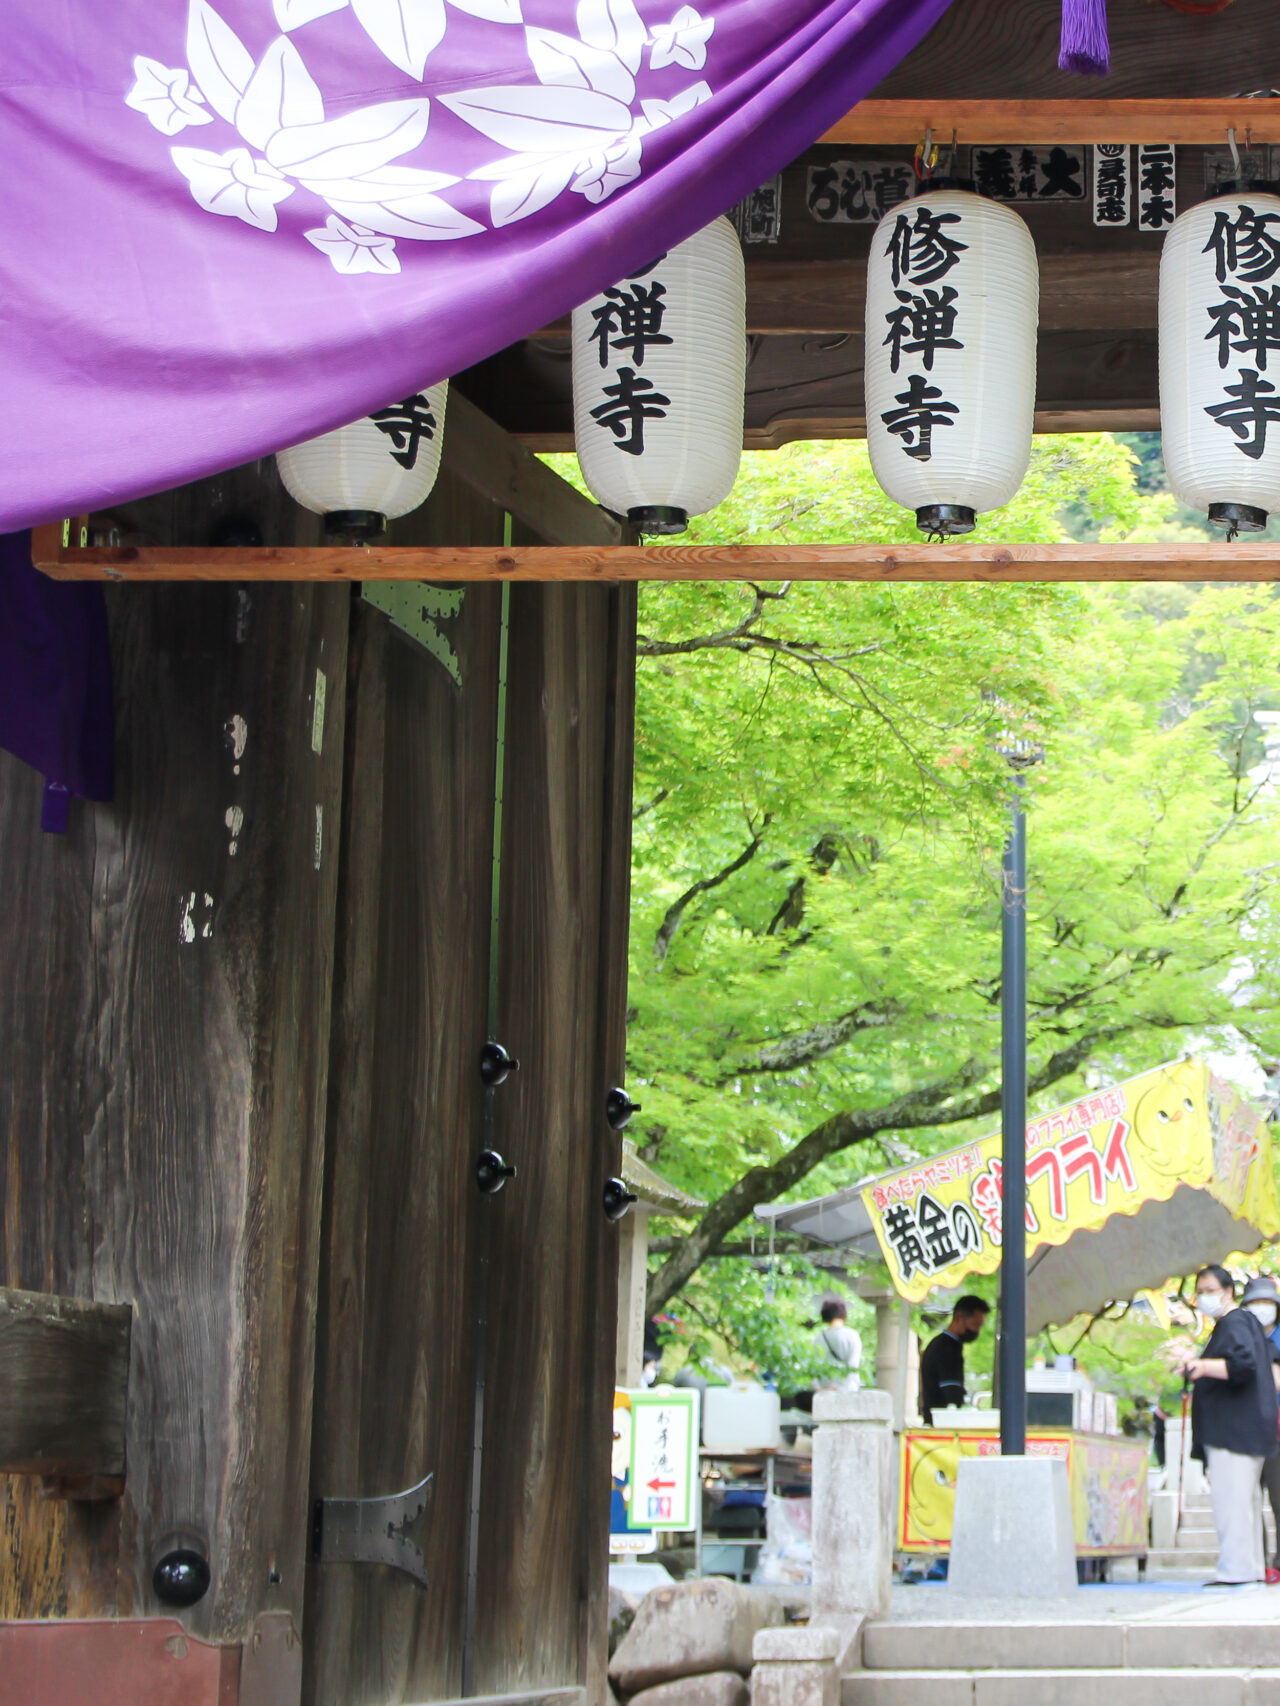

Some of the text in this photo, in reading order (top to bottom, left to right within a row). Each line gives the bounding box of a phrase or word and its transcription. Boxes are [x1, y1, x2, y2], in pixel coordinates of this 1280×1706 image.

[587, 253, 674, 456] 禅寺
[880, 207, 969, 462] 修禅寺
[1025, 1087, 1128, 1151] のフライ専門店!
